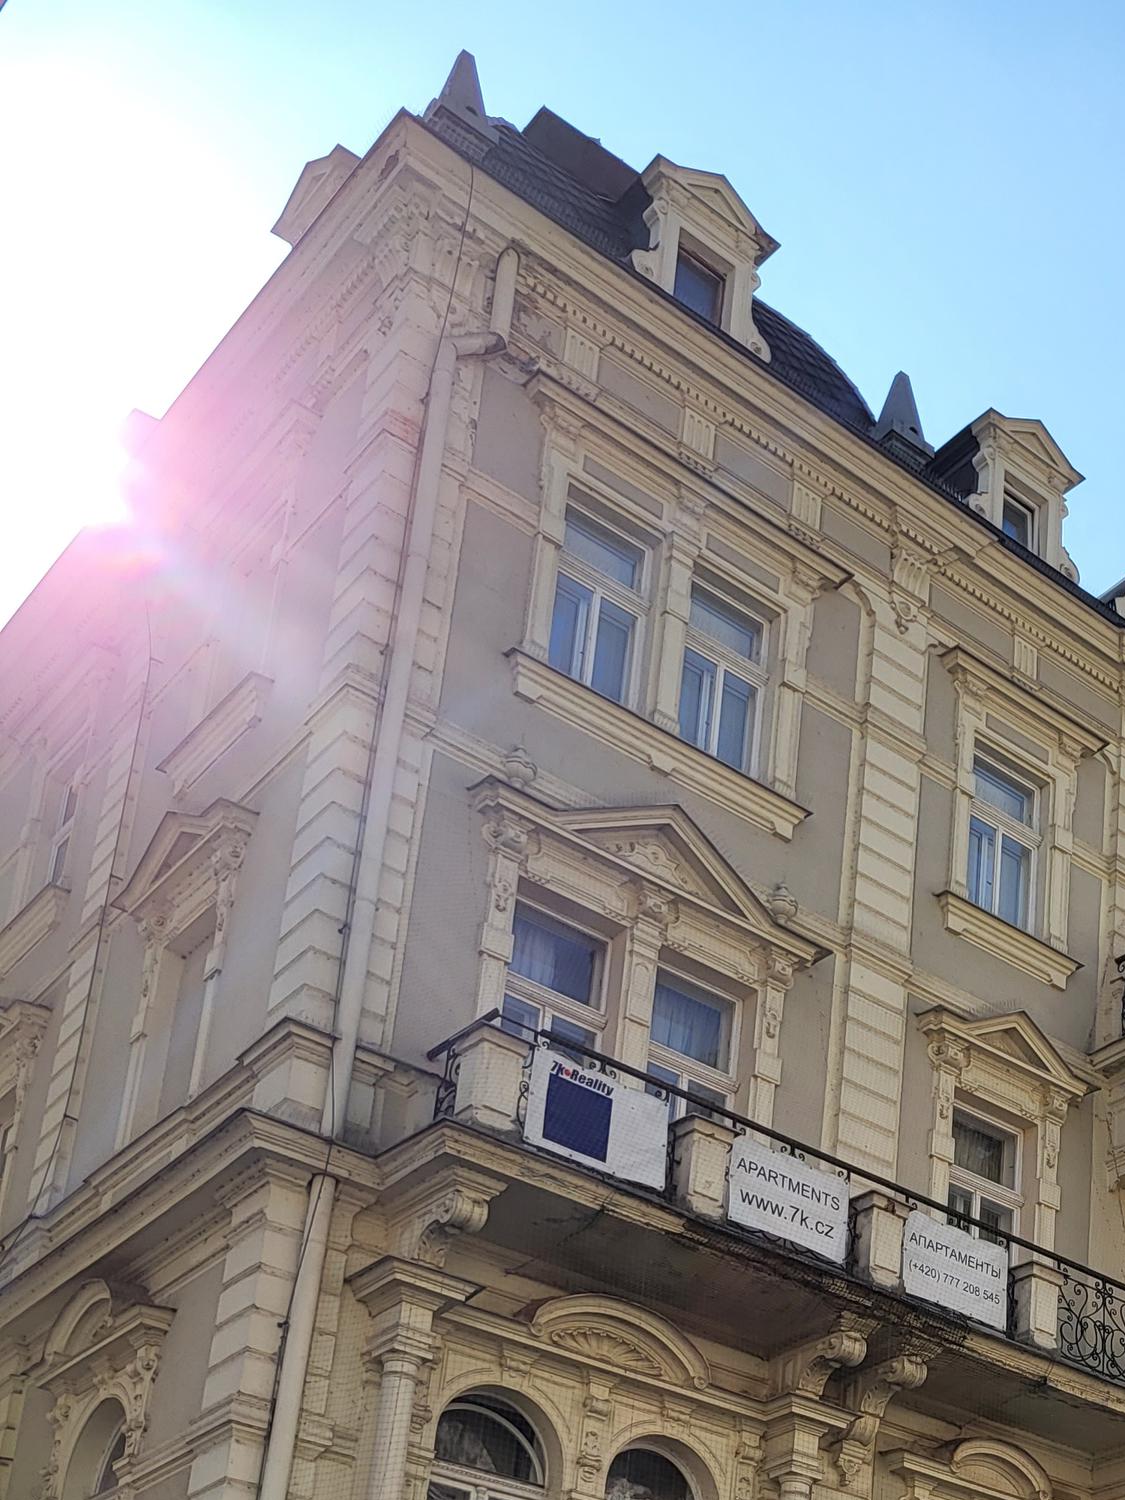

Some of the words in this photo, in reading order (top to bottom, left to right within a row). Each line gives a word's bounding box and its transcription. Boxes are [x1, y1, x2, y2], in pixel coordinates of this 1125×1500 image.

[737, 1157, 840, 1211] APARTMENTS
[909, 1232, 1001, 1279] АПАРТАМЕНТЫ
[909, 1259, 941, 1283] (+420)
[943, 1272, 960, 1288] 777
[963, 1281, 980, 1297] 208
[983, 1289, 1000, 1305] 545
